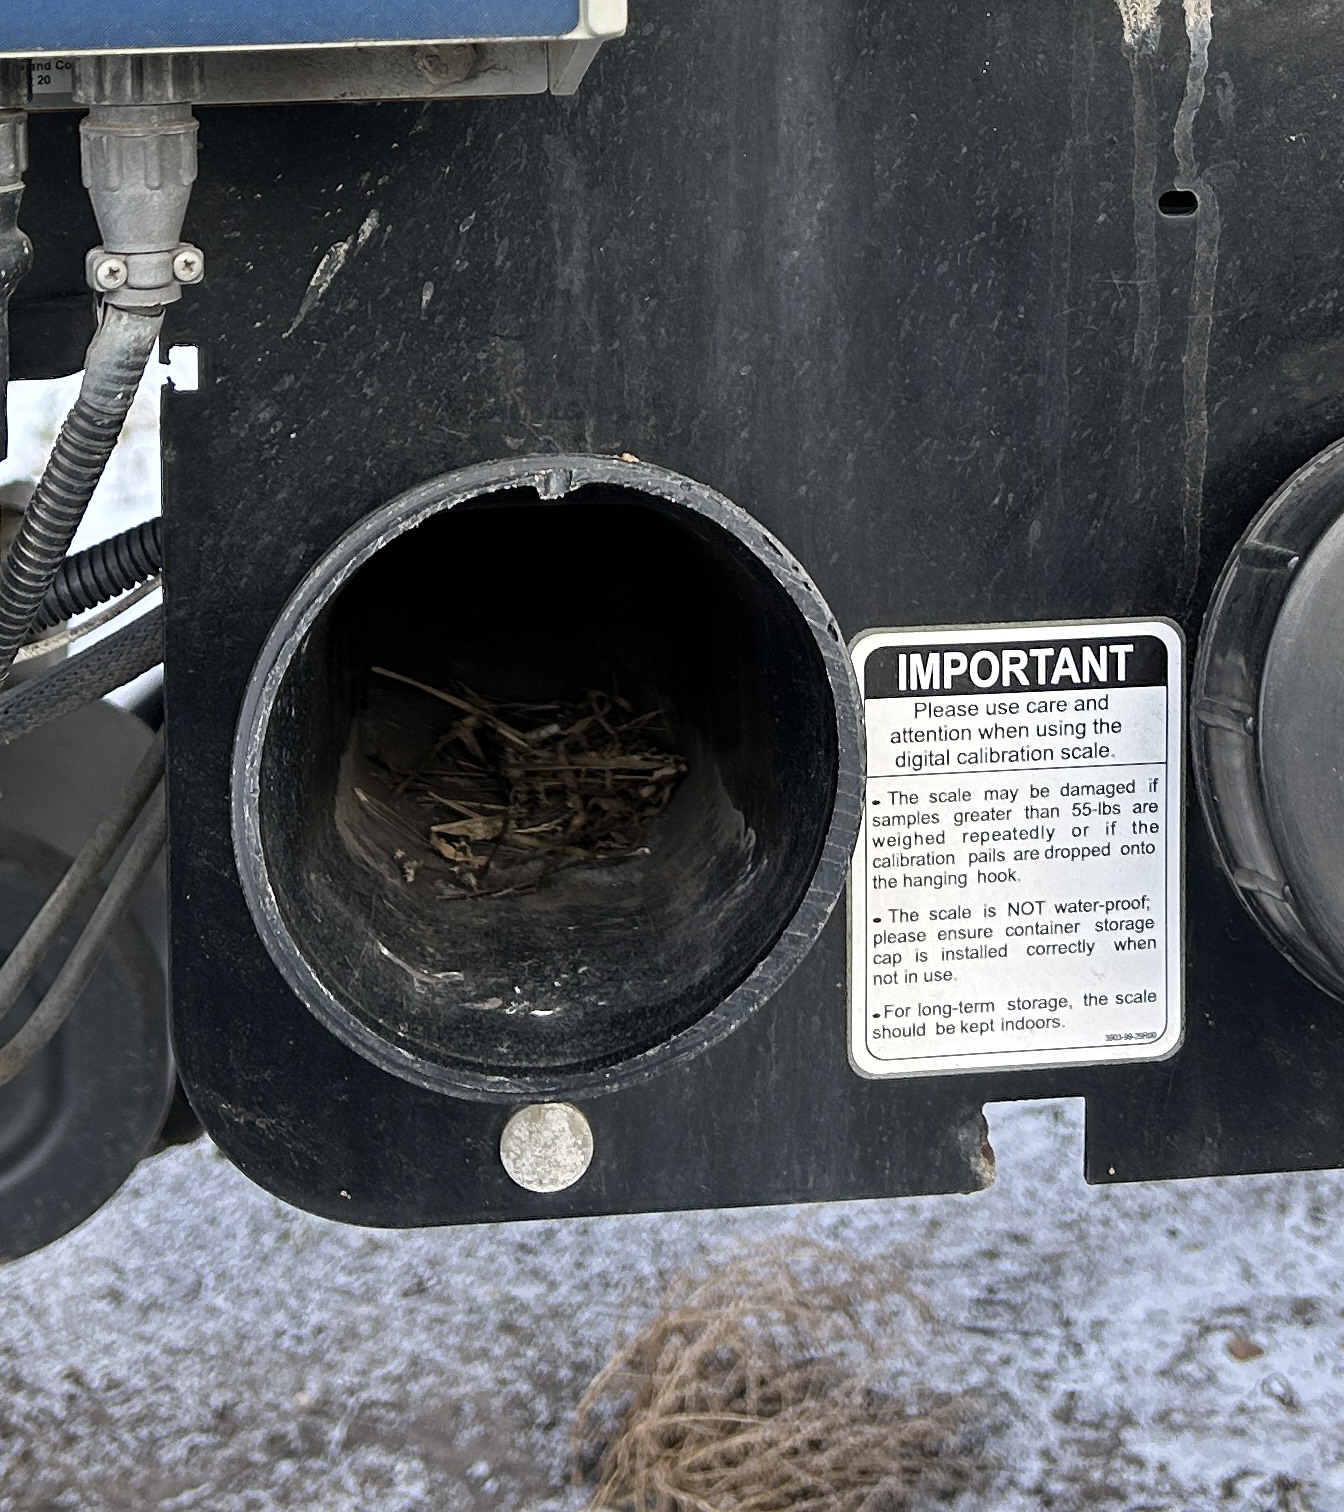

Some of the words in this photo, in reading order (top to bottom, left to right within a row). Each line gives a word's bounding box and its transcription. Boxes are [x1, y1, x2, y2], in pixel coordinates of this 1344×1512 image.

[897, 644, 1134, 691] IMPORTANT
[914, 702, 979, 719] Please
[986, 702, 1020, 716] use
[1026, 700, 1068, 714] care
[1074, 694, 1109, 712] and
[890, 725, 972, 744] attention
[978, 722, 1029, 740] when
[1036, 720, 1086, 740] using
[1092, 718, 1122, 735] the
[895, 748, 950, 772] digital
[957, 744, 1054, 765] calibration
[1060, 742, 1115, 760] scale.
[887, 791, 919, 806] The
[929, 788, 972, 804] scale
[984, 788, 1019, 804] may
[1030, 784, 1050, 799] be
[1060, 779, 1135, 798] damaged
[1148, 778, 1159, 793] if
[872, 810, 940, 829] samples
[953, 807, 1013, 827] greater
[1024, 805, 1060, 820] than
[1072, 801, 1121, 817] 55-lbs
[1132, 802, 1158, 814] are
[872, 830, 945, 850] weighed
[962, 825, 1056, 846] repeatedly
[1071, 825, 1090, 838] or
[1106, 821, 1117, 836] if
[1132, 820, 1159, 835] the
[872, 851, 955, 869] calibration
[968, 848, 1006, 868] pails
[1013, 849, 1040, 861] are
[1044, 842, 1111, 862] dropped
[1120, 841, 1156, 856] onto
[872, 875, 898, 890] the
[903, 871, 967, 890] hanging
[977, 868, 1021, 884] hook.
[887, 908, 919, 924] The
[929, 905, 972, 921] scale
[983, 903, 997, 919] is
[1007, 900, 1047, 917] NOT
[873, 930, 927, 949] please
[937, 927, 993, 941] ensure
[1005, 920, 1081, 937] container
[1094, 918, 1155, 934] storage
[873, 953, 902, 968] cap
[915, 948, 928, 963] is
[941, 943, 1008, 961] installed
[1026, 939, 1096, 957] correctly
[1113, 937, 1157, 951] when
[873, 970, 899, 986] not
[904, 969, 918, 984] in
[923, 970, 957, 983] use.
[884, 1004, 911, 1019] For
[918, 1001, 995, 1019] long-term
[1007, 997, 1073, 1012] storage,
[1083, 993, 1108, 1007] the
[1115, 989, 1157, 1005] scale
[873, 1022, 926, 1040] should
[935, 1021, 956, 1035] be
[960, 1018, 995, 1036] kept
[1001, 1016, 1065, 1031] indoors.
